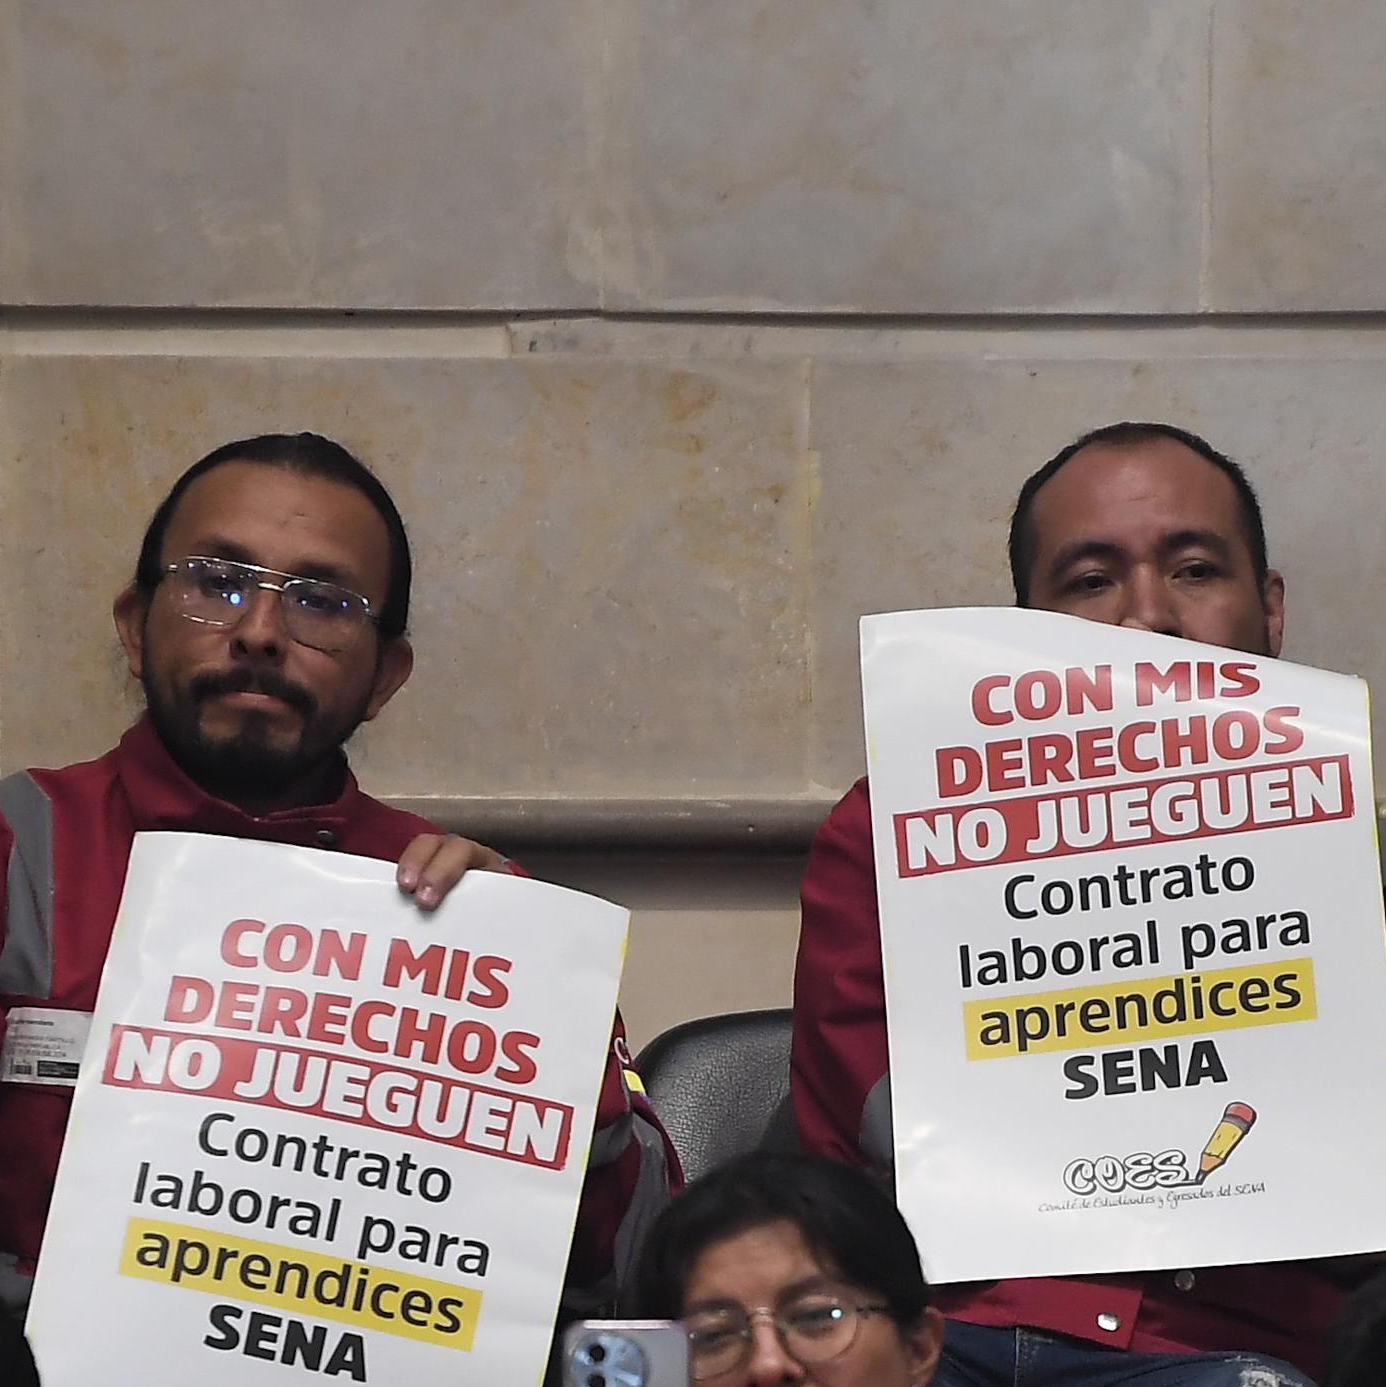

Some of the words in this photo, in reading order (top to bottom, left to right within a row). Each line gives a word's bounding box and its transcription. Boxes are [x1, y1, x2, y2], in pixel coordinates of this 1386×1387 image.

[973, 668, 1113, 726] CON
[1137, 663, 1259, 705] MIS
[938, 709, 1303, 799] DERECHOS
[906, 808, 1006, 869] NO
[1027, 762, 1342, 853] JUEGUEN
[1005, 849, 1254, 919] Contrato
[225, 922, 366, 979] CON
[385, 940, 512, 1008] MIS
[960, 920, 1159, 987] laboral
[1182, 912, 1309, 970] para
[167, 977, 540, 1084] DERECHOS
[981, 974, 1300, 1051] aprendices
[113, 1033, 220, 1090] NO
[234, 1063, 572, 1162] JUEGUEN
[1064, 1040, 1227, 1099] SENA
[199, 1114, 451, 1202] Contrato
[1063, 1150, 1189, 1195] COES
[134, 1163, 341, 1241] laboral
[358, 1216, 489, 1276] para
[137, 1226, 463, 1333] aprendices
[204, 1305, 366, 1382] SENA
